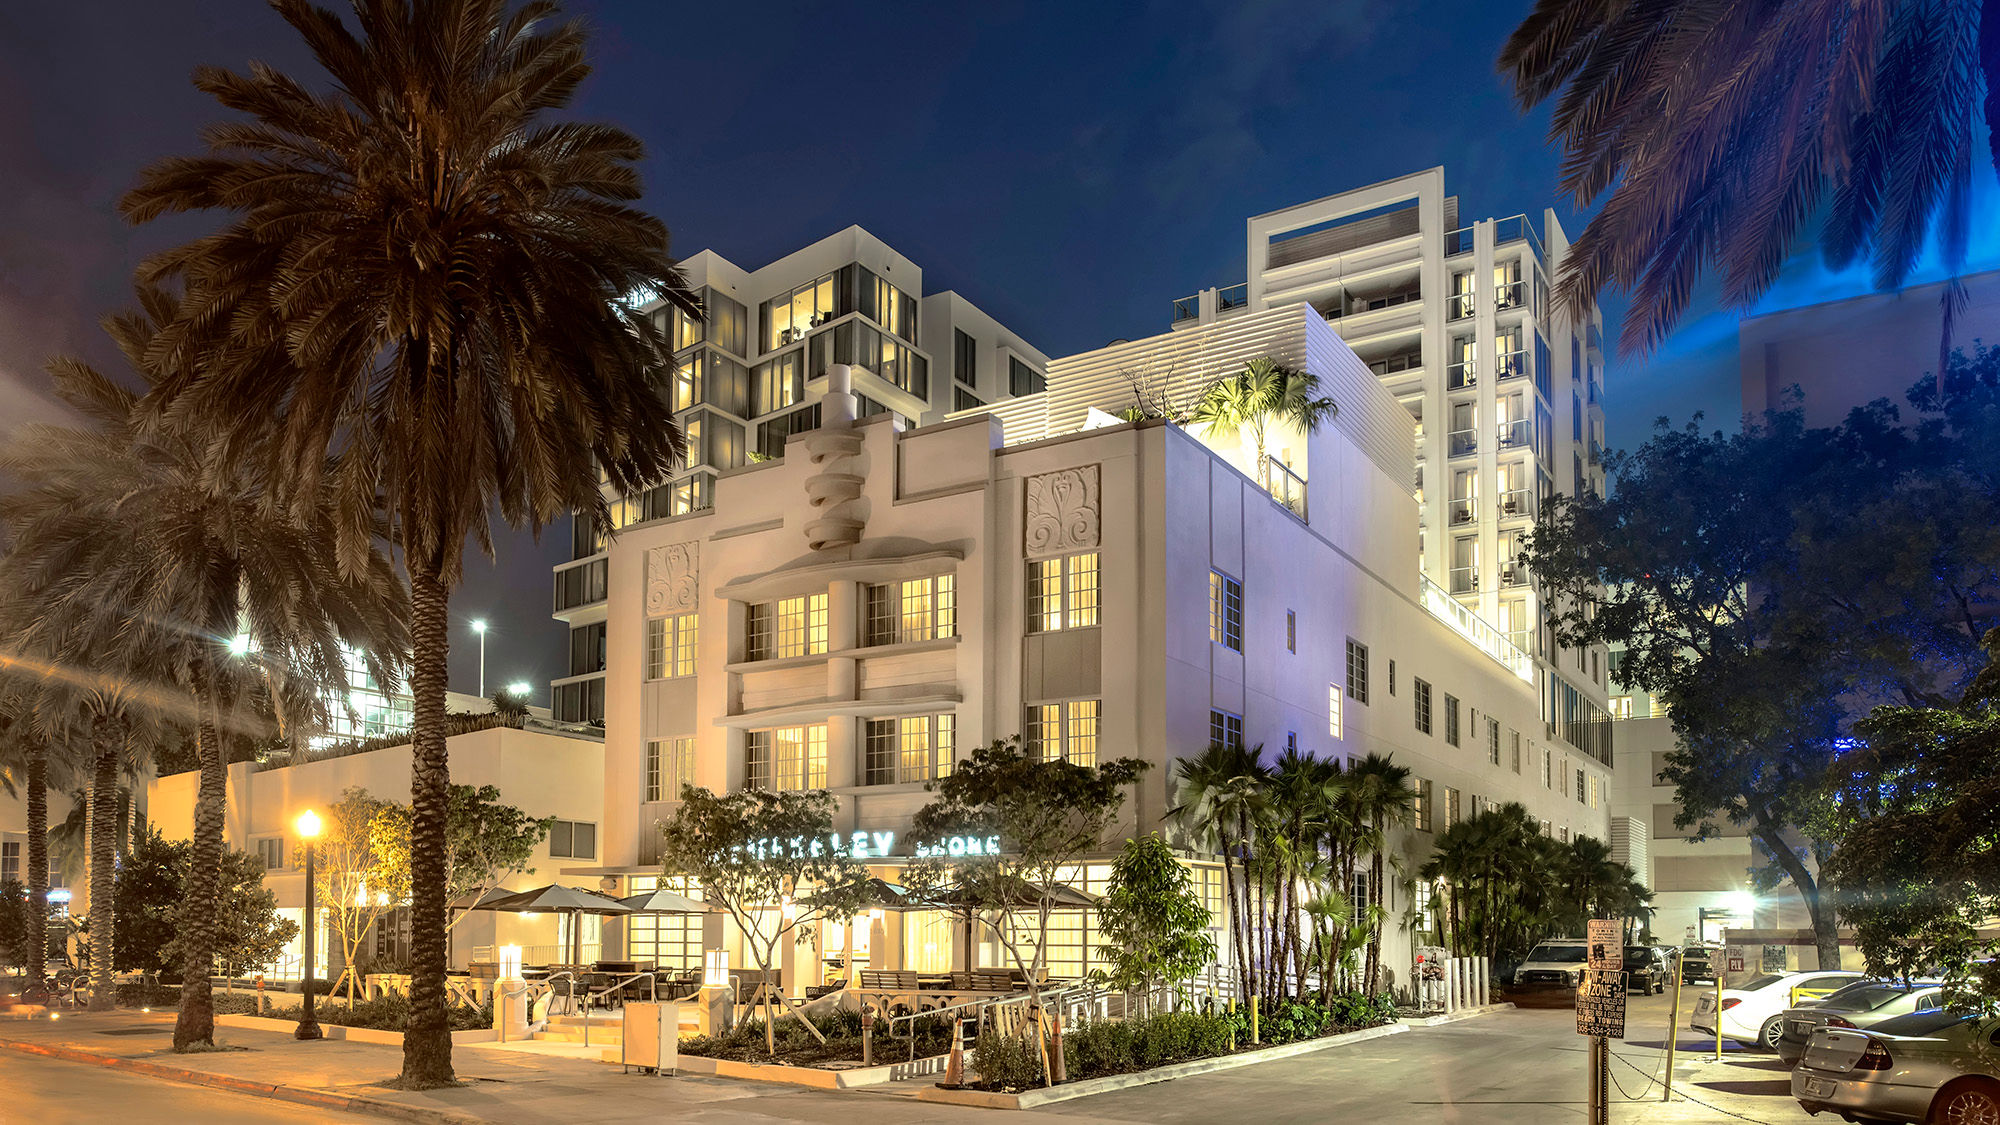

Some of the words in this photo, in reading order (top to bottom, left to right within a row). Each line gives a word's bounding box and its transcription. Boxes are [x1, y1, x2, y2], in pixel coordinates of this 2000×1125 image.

[1591, 960, 1601, 968] 24
[1590, 984, 1611, 997] ZONE
[1598, 1017, 1623, 1026] TOWING
